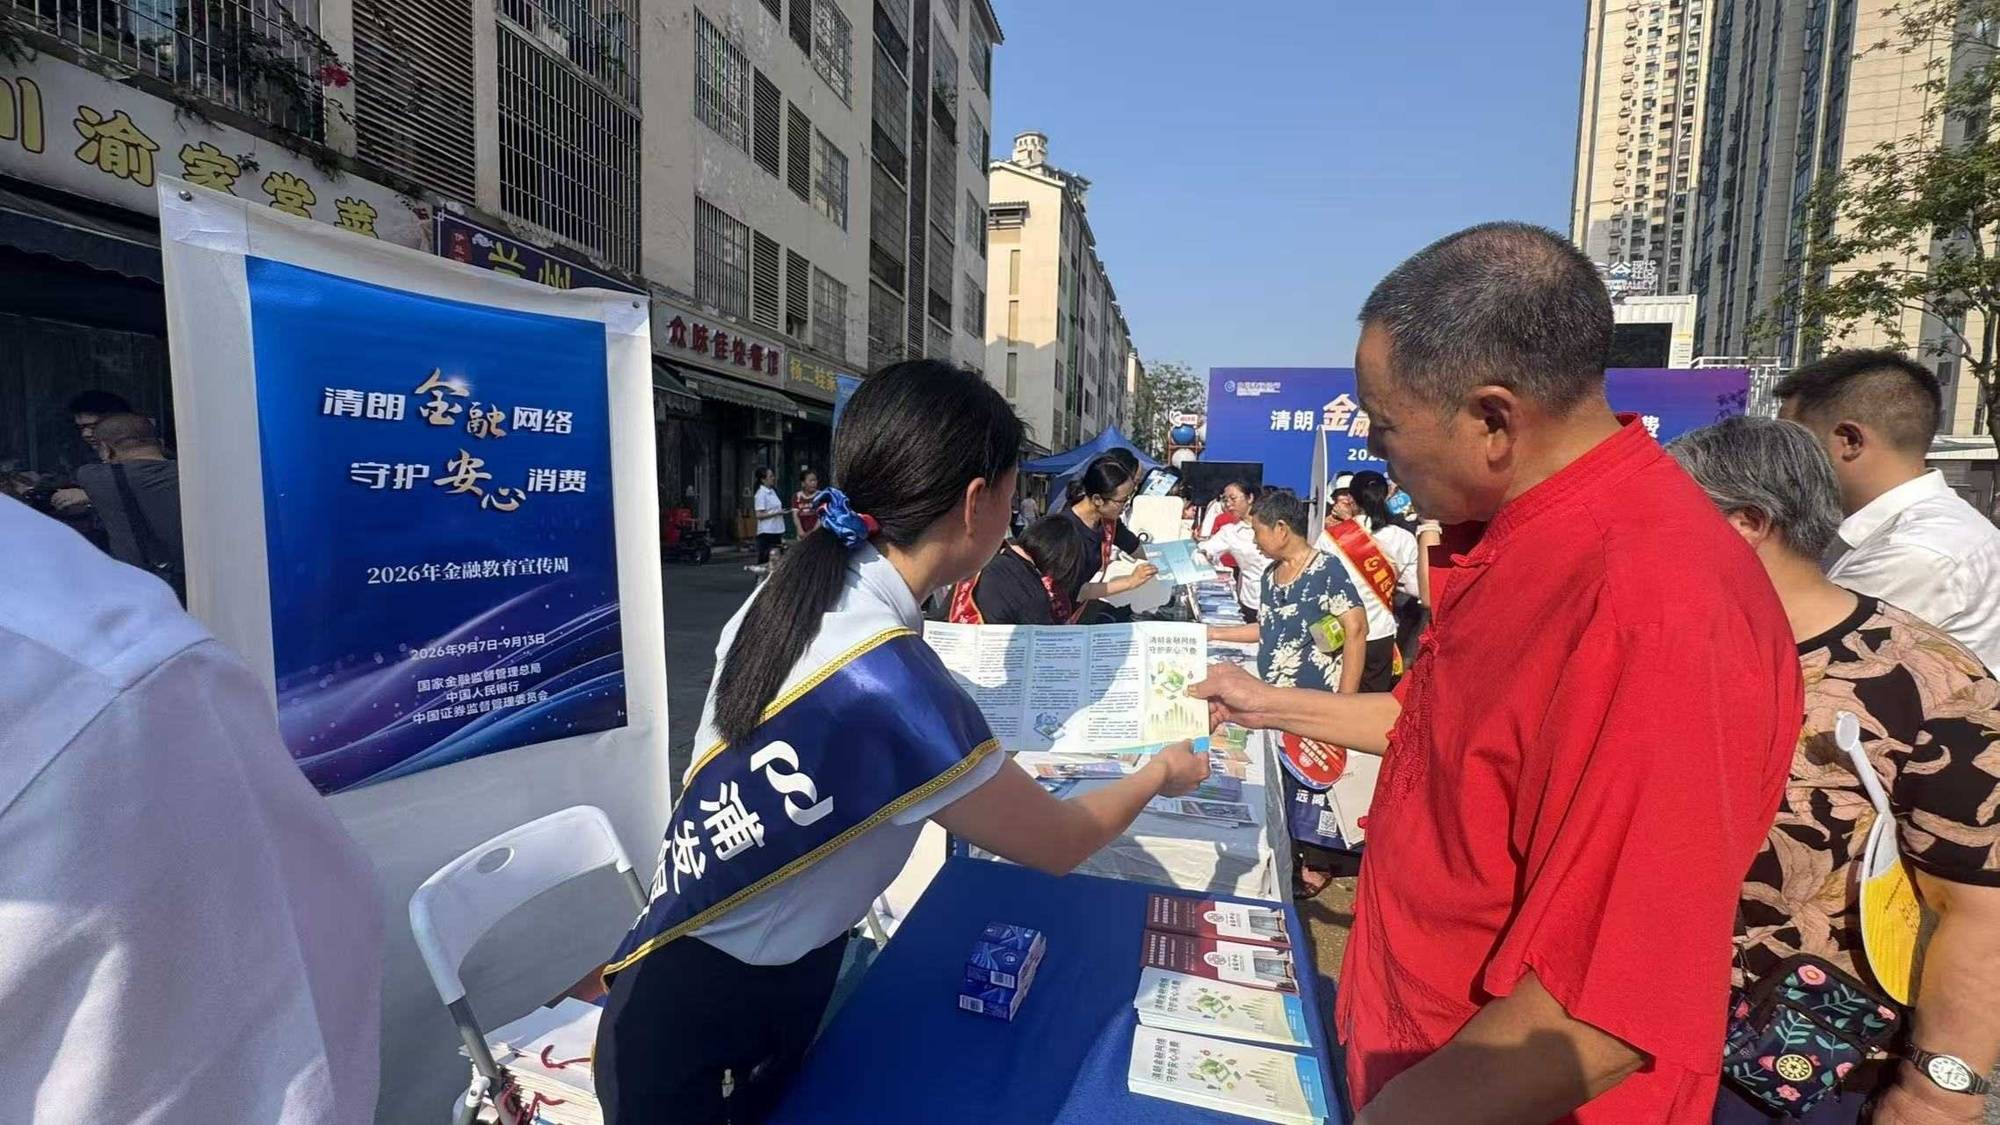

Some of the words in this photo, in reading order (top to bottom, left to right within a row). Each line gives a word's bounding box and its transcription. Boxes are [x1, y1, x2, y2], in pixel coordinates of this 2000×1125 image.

[322, 367, 573, 439] 清朗金融网络
[1347, 448, 1386, 462] 20
[350, 449, 587, 512] 守护安心消费
[367, 556, 570, 584] 2026年金融教育宣传周
[411, 633, 546, 662] 2026年9月7日-9月13日
[417, 662, 542, 693] 国家金融监督管理总局
[446, 681, 520, 703] 中国人民银行
[412, 690, 550, 725] 中国证券监督管理委员会
[631, 780, 766, 931] 浦发
